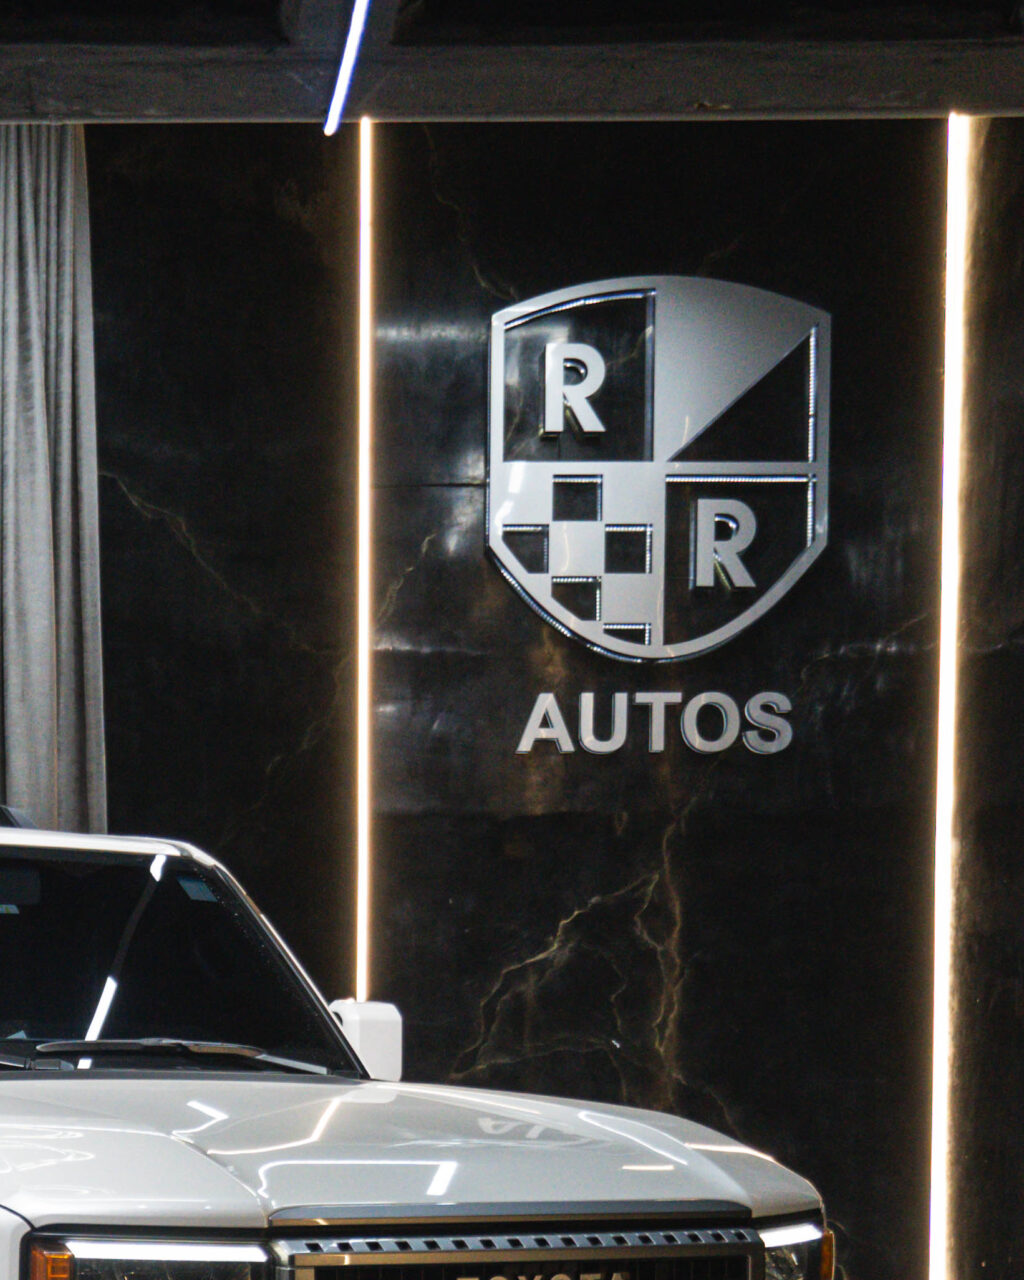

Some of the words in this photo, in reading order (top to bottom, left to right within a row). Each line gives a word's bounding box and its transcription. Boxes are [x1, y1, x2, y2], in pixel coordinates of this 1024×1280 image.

[542, 342, 607, 435] R
[693, 498, 757, 589] R
[515, 691, 793, 754] AUTOS
